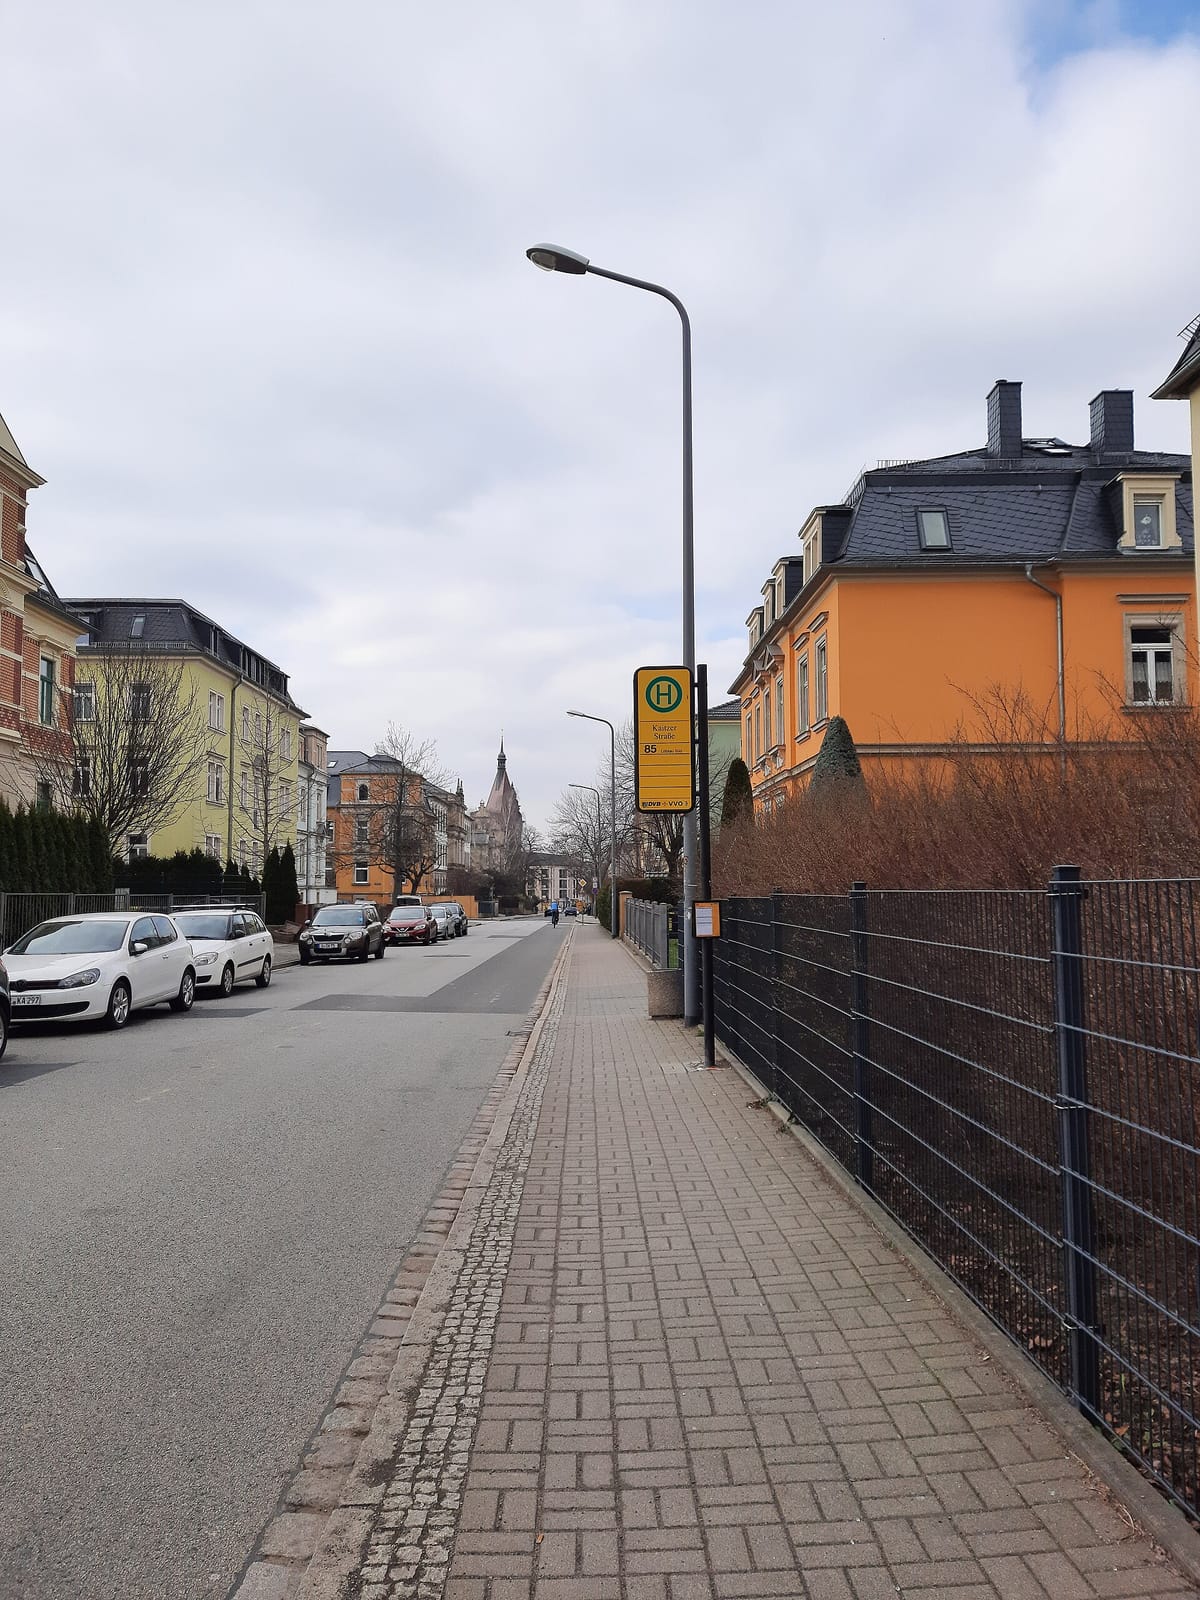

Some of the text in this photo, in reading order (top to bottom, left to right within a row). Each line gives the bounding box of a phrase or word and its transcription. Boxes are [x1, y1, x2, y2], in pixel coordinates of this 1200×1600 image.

[656, 684, 672, 705] H
[652, 724, 677, 732] Kaitzer
[654, 732, 676, 740] Straße
[644, 744, 657, 753] 85
